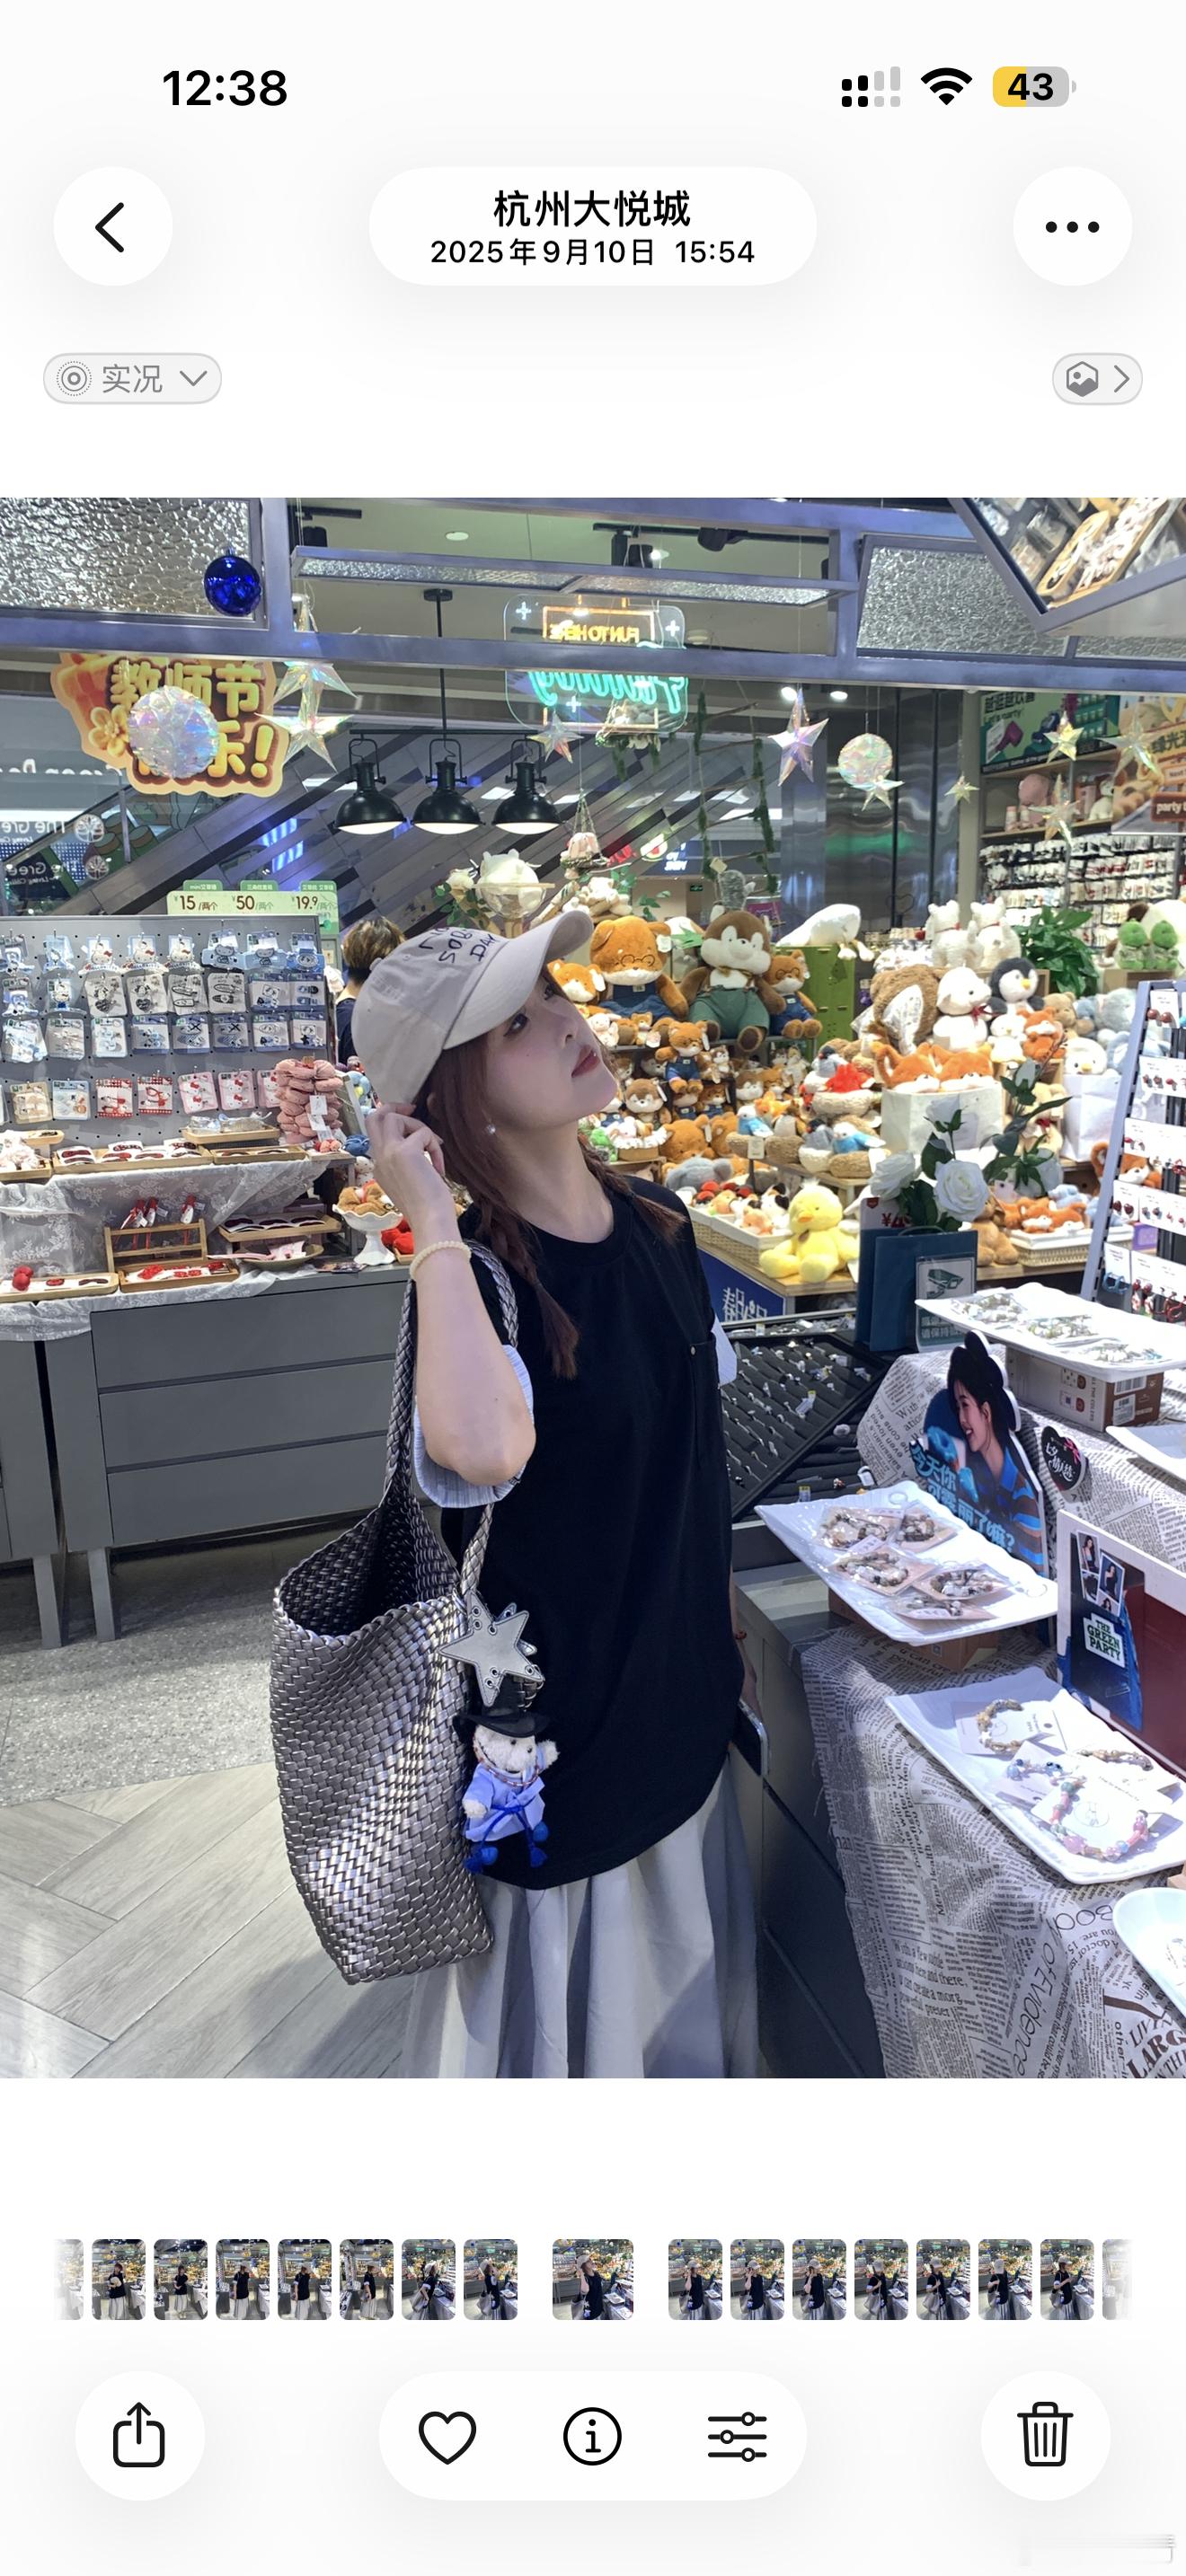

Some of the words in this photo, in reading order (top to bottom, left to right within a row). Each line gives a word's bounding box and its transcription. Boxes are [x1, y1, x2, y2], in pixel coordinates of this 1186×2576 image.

[896, 1402, 918, 1420] With
[886, 1434, 903, 1459] even
[1086, 1623, 1120, 1650] GREEN
[1094, 1619, 1111, 1635] THE
[1089, 1636, 1121, 1662] PARTY
[1077, 1938, 1111, 1960] doctor
[1013, 1966, 1054, 2078] Evidence
